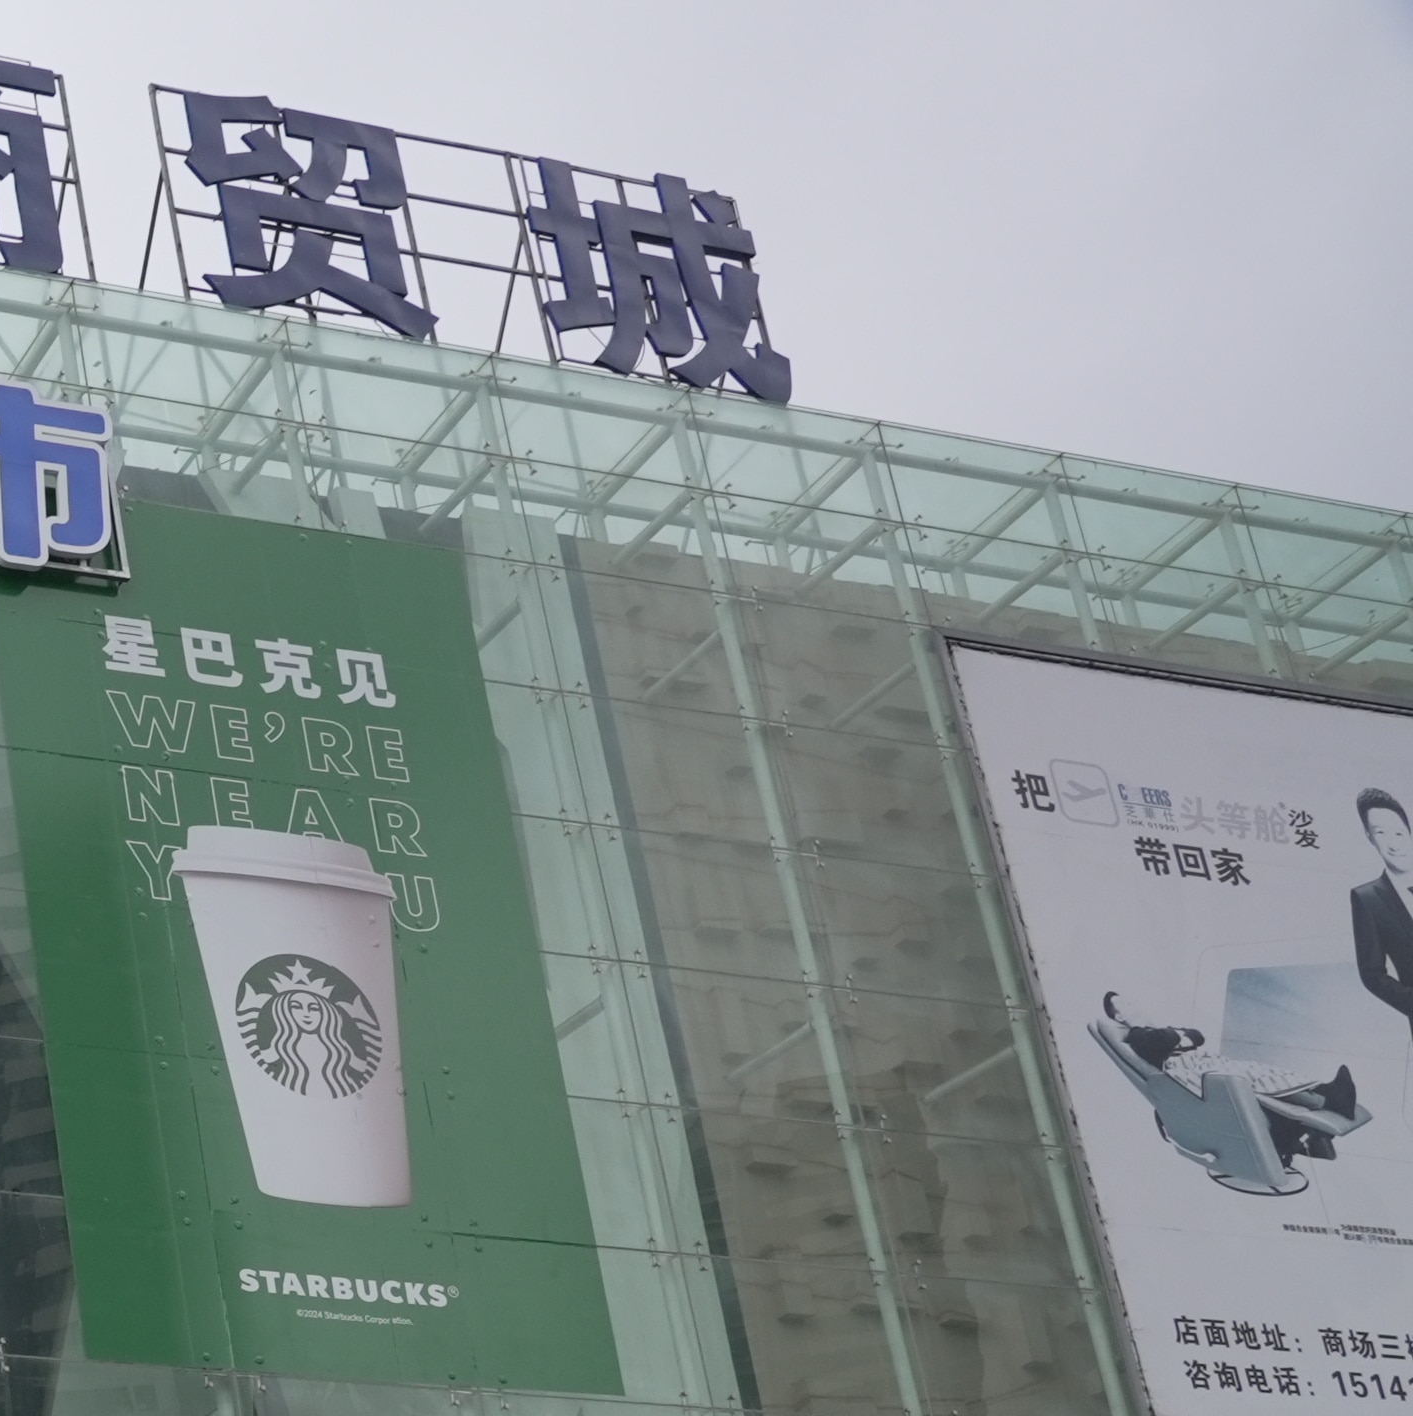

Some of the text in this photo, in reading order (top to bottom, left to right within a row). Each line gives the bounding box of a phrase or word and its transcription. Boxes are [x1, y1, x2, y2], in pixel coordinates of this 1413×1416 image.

[103, 615, 397, 709] 星巴克见
[105, 689, 411, 784] WE'RE
[122, 764, 426, 858] NEAR
[1011, 769, 1056, 814] 把
[1117, 783, 1172, 808] CEERS
[126, 840, 441, 932] YU
[1133, 836, 1251, 886] 带回家
[1184, 1358, 1413, 1402] 咨询电话：1514
